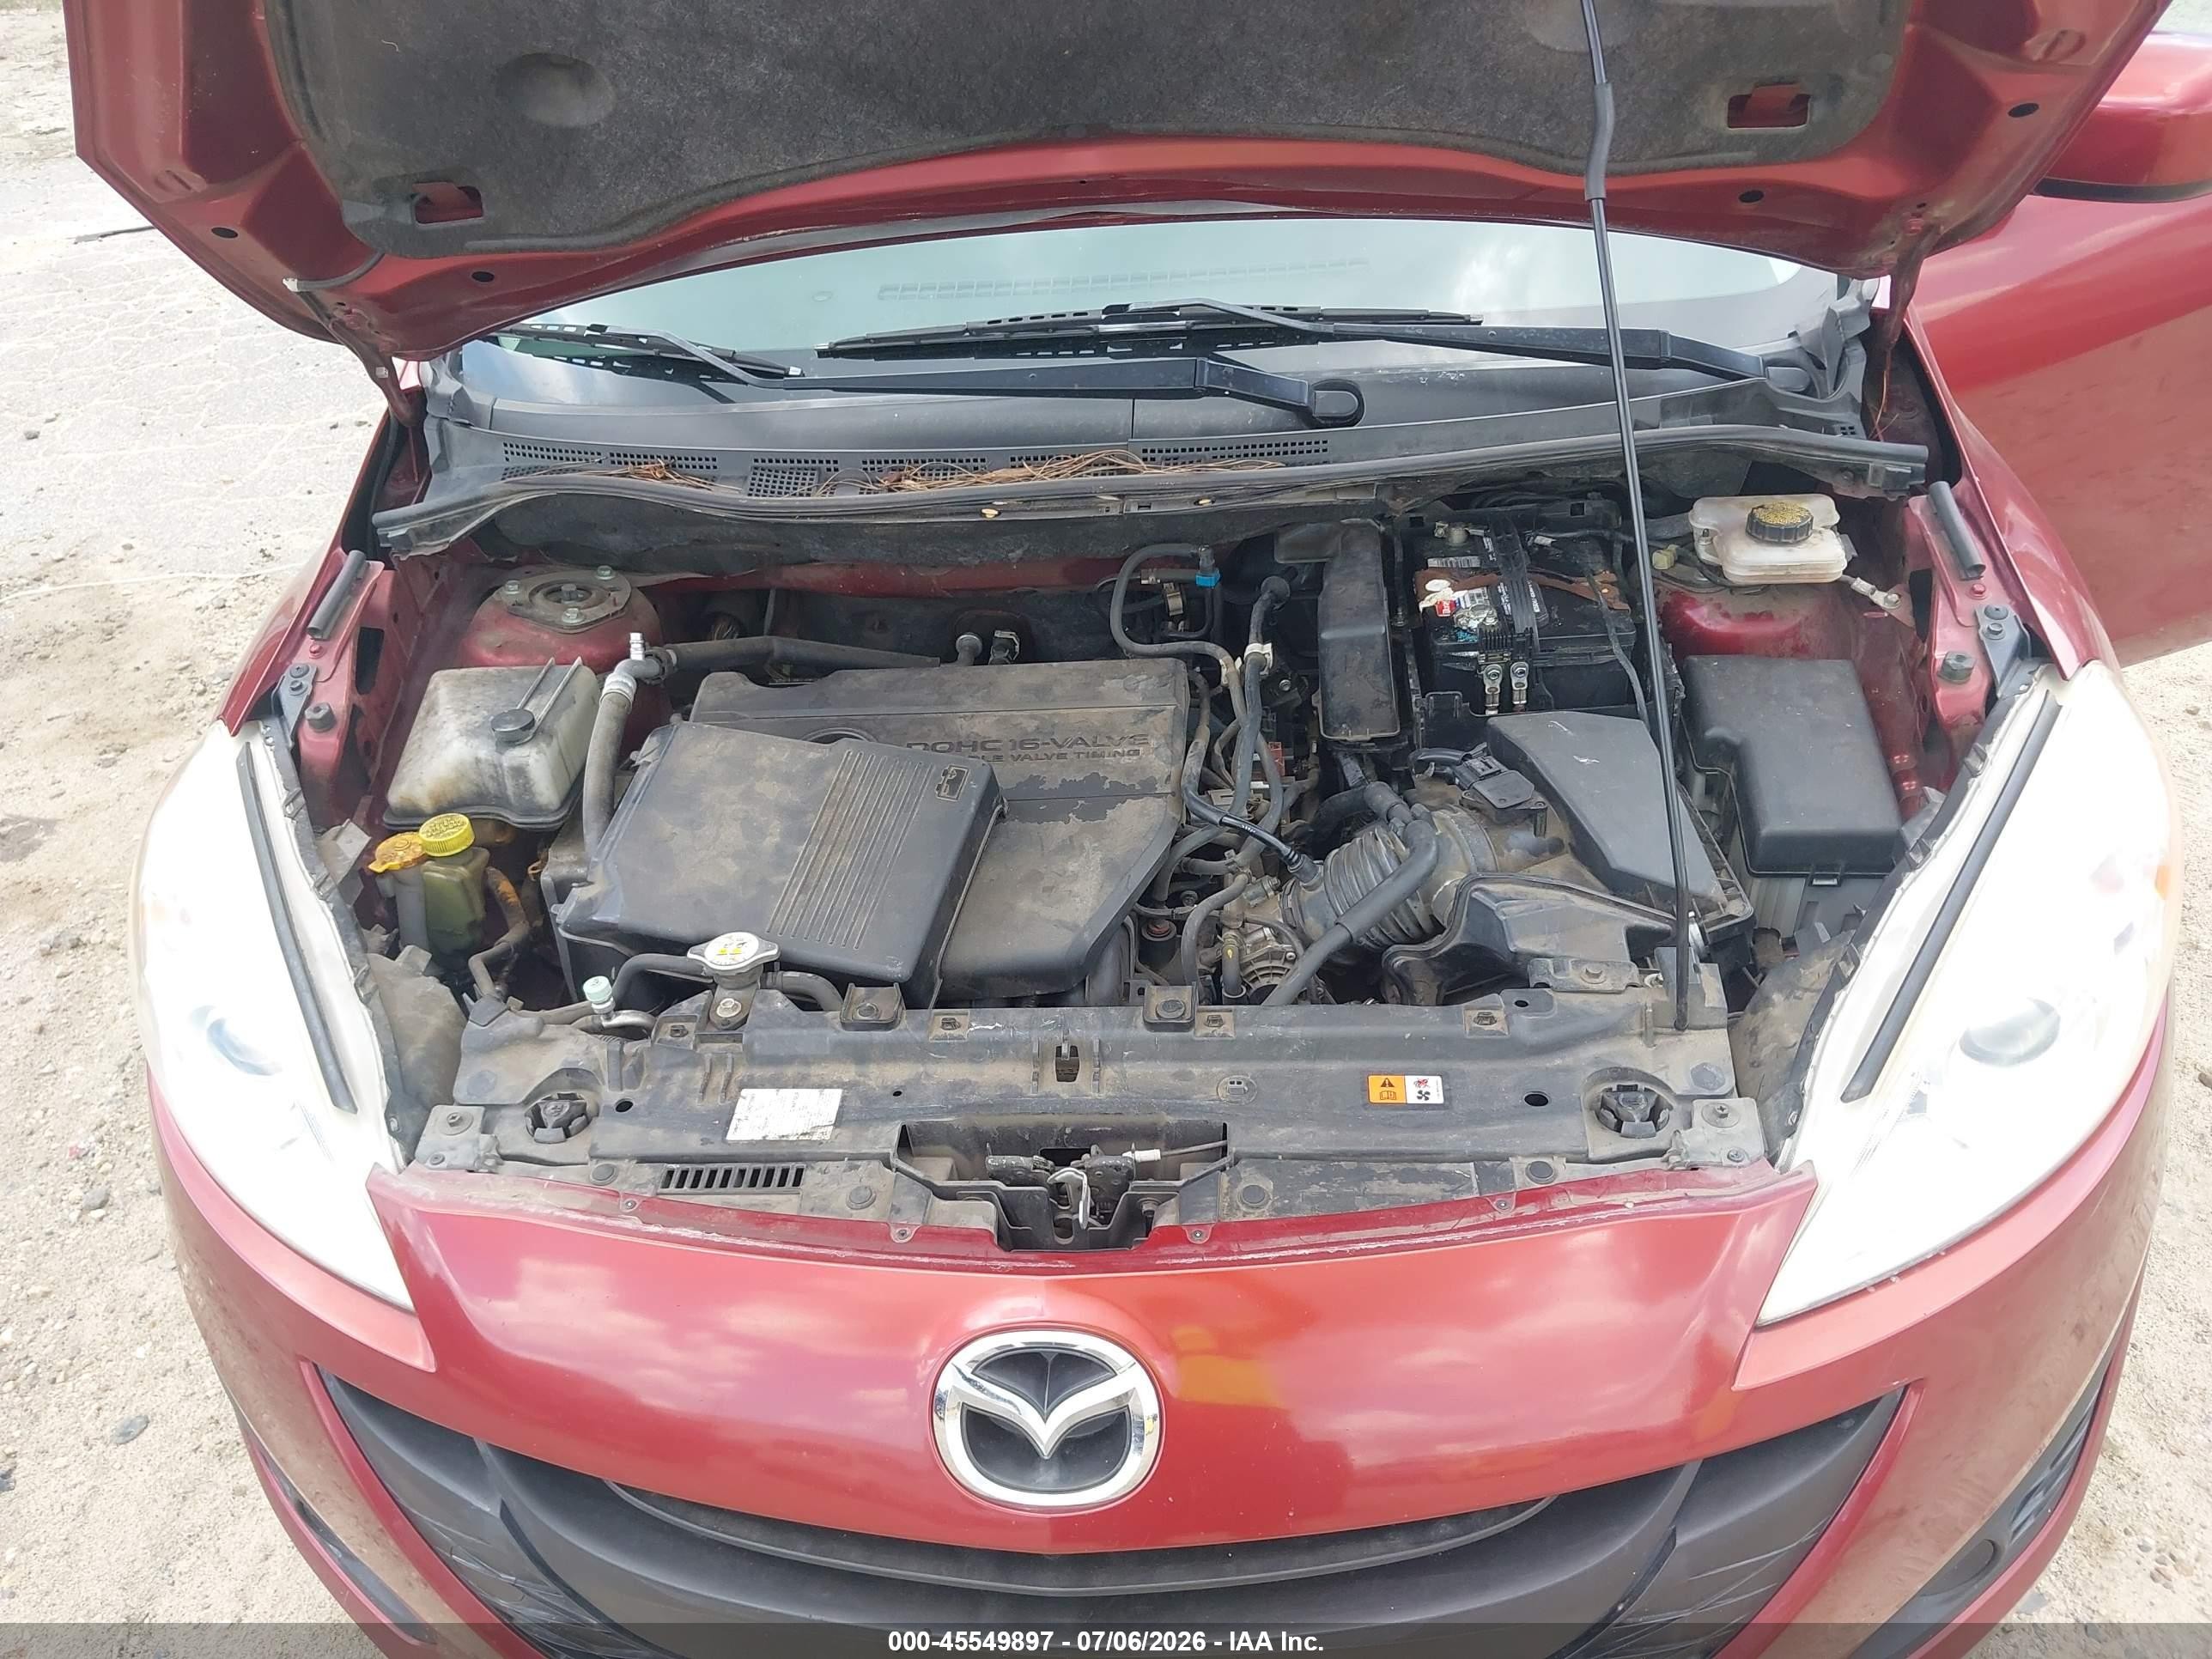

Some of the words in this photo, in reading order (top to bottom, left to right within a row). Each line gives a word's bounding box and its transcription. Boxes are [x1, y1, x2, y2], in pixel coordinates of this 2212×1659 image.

[1008, 732, 1150, 751] 16-VALVE
[1010, 751, 1068, 763] VALVE
[1073, 749, 1142, 760] TIMING
